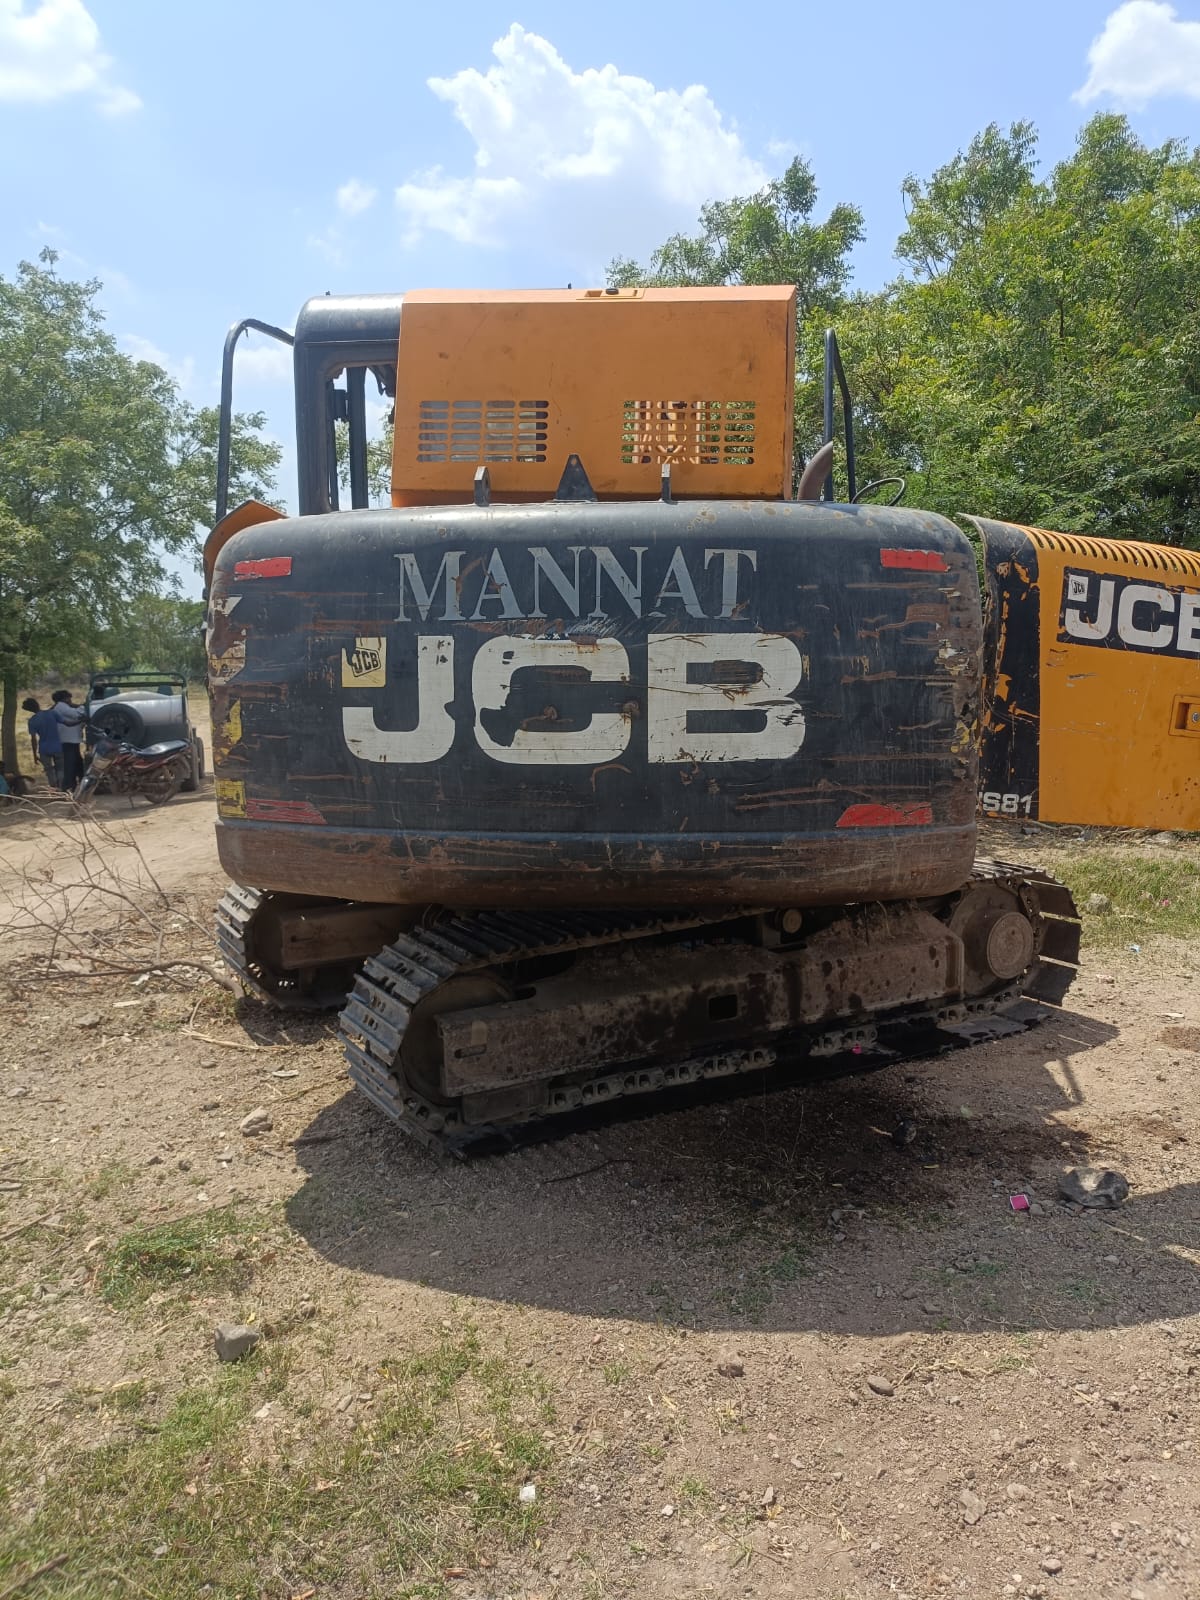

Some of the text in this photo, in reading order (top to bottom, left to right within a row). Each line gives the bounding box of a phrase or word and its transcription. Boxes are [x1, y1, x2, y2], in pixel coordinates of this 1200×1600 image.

[394, 546, 757, 622] MANNAT
[342, 633, 806, 765] JCB
[352, 650, 379, 674] JCB
